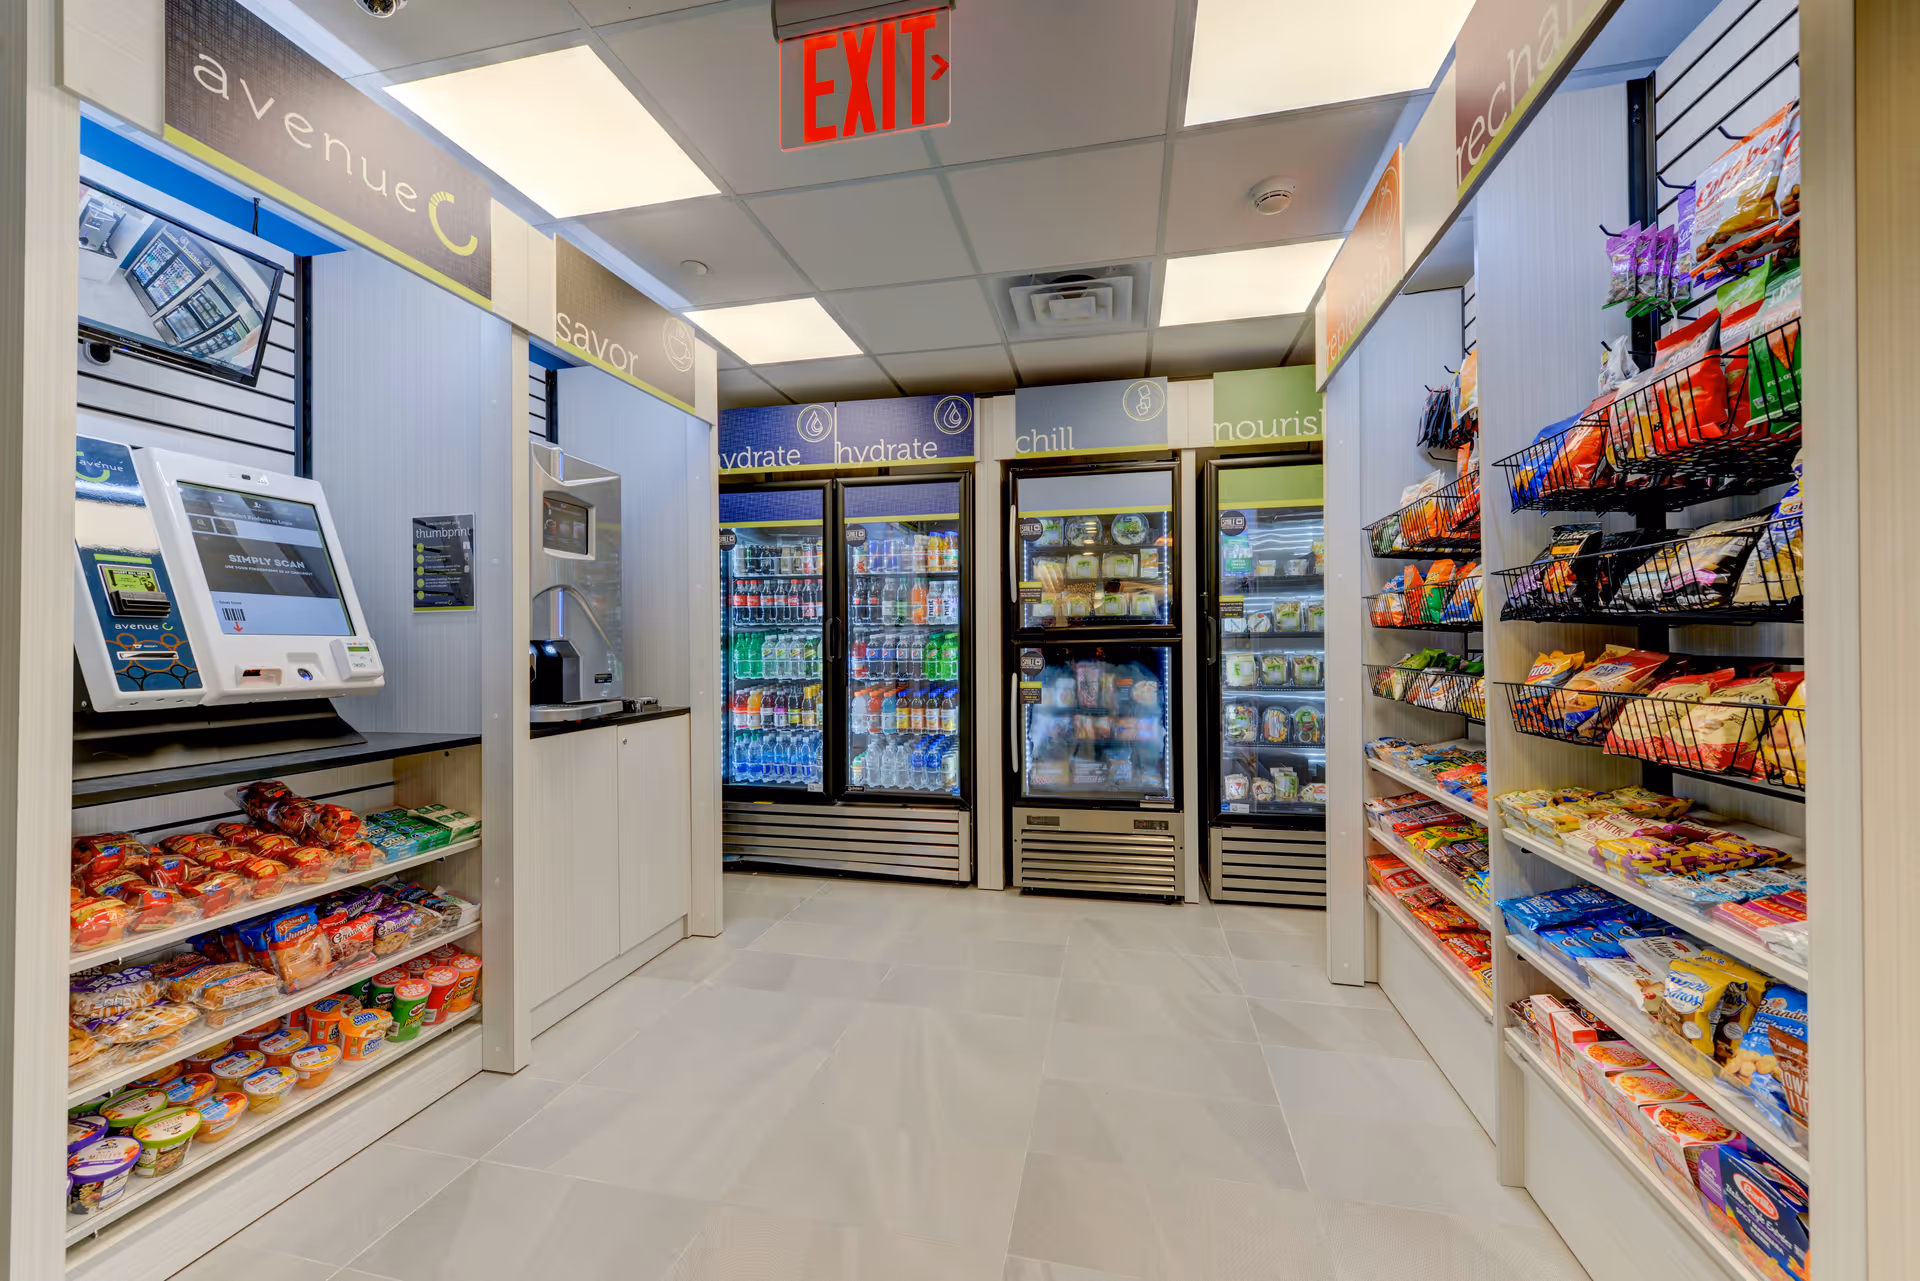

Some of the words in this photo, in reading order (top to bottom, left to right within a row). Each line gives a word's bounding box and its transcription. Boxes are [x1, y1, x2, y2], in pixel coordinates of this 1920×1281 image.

[804, 14, 936, 143] EXIT
[193, 53, 417, 213] avenue
[556, 312, 638, 377] savor
[836, 438, 938, 468] hydrate
[1015, 426, 1075, 454] chill
[416, 527, 471, 539] thumbprint
[228, 554, 271, 566] SIMPLY
[274, 559, 305, 569] SCAN
[285, 922, 318, 942] Jumbo
[1663, 989, 1704, 1008] Amos
